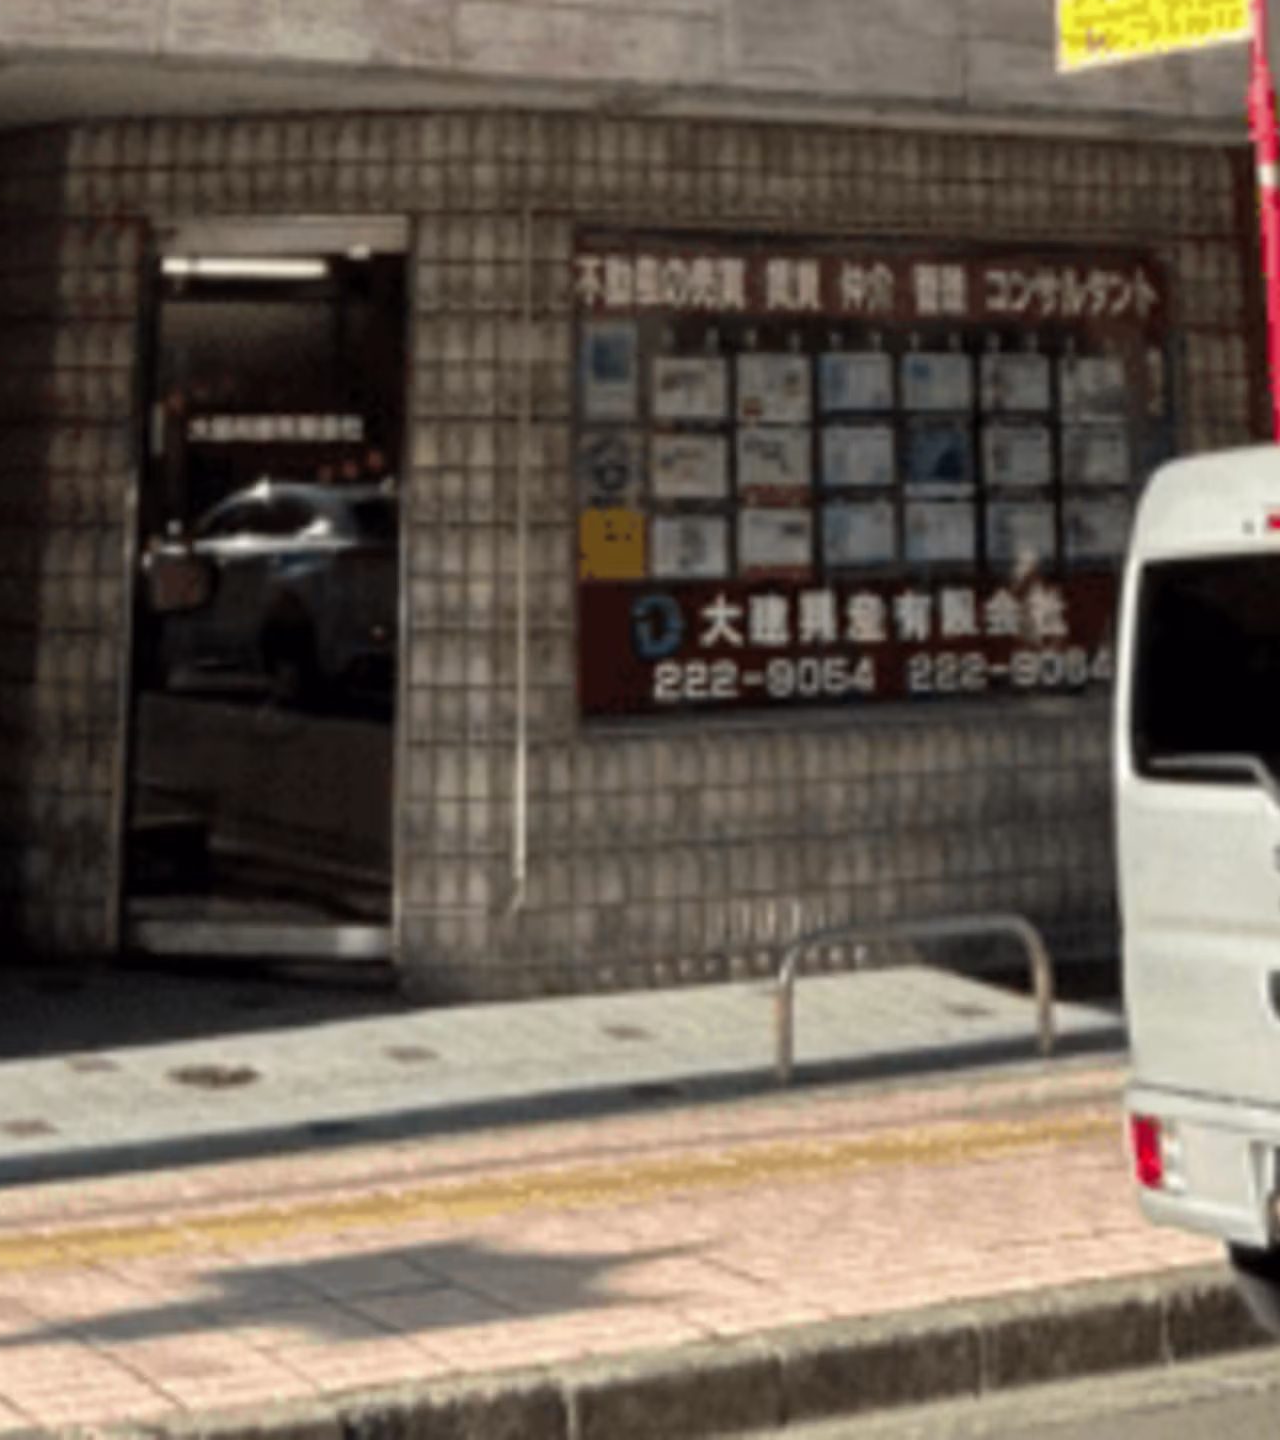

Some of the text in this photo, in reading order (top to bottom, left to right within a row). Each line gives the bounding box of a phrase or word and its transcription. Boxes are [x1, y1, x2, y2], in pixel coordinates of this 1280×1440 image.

[982, 262, 1159, 318] コンサルタント
